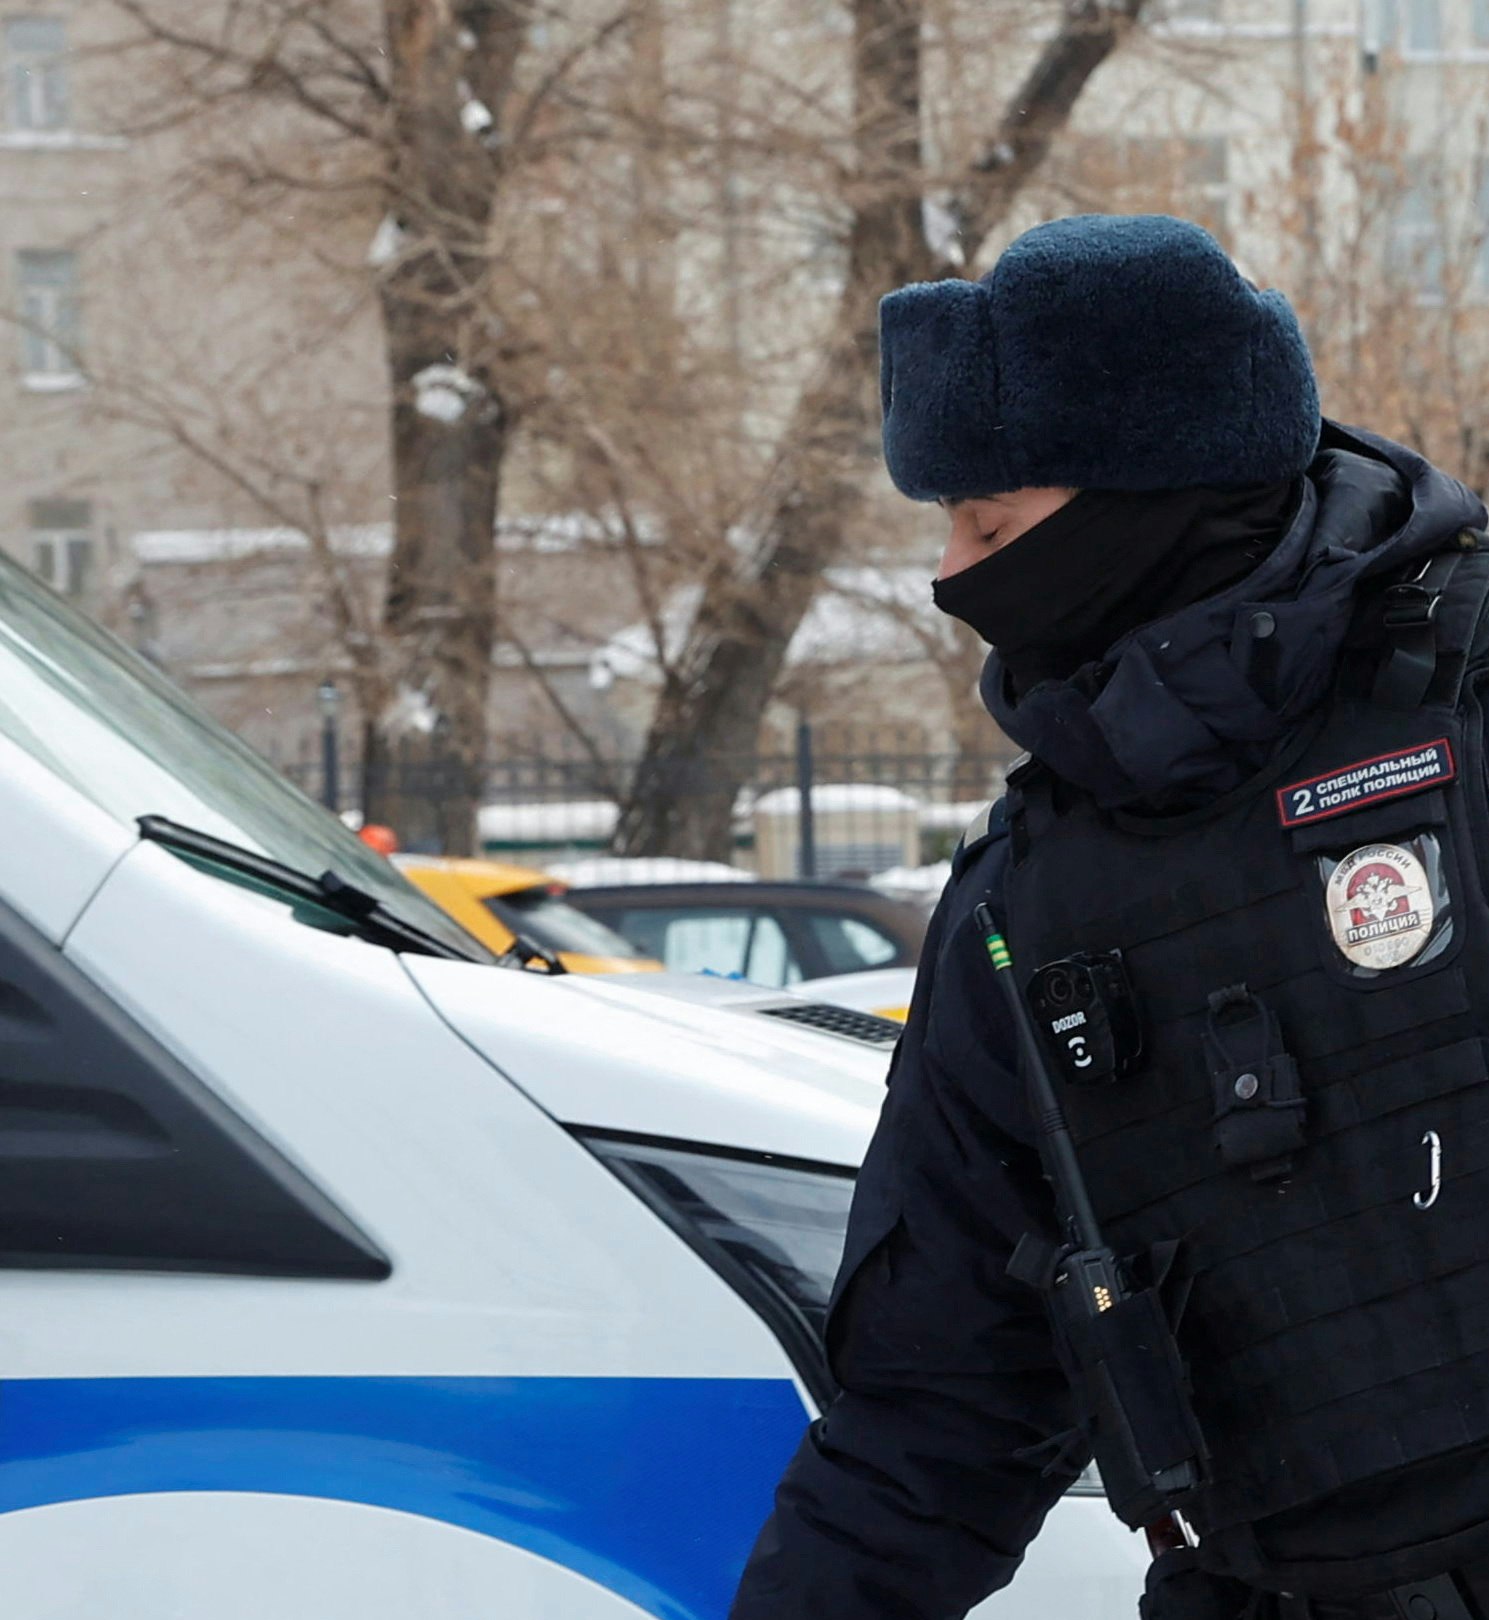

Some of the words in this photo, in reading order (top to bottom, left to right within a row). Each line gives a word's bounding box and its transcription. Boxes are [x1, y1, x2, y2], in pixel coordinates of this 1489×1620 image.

[1316, 748, 1438, 795] СПЕЦИАЛЬНЫЙ
[1319, 786, 1361, 808] ПОЛК
[1363, 763, 1441, 793] ПОЛИЦИИ
[1292, 789, 1314, 816] 2
[1348, 913, 1418, 942] ПОЛИЦИЯ
[1051, 1011, 1087, 1034] DOZOR
